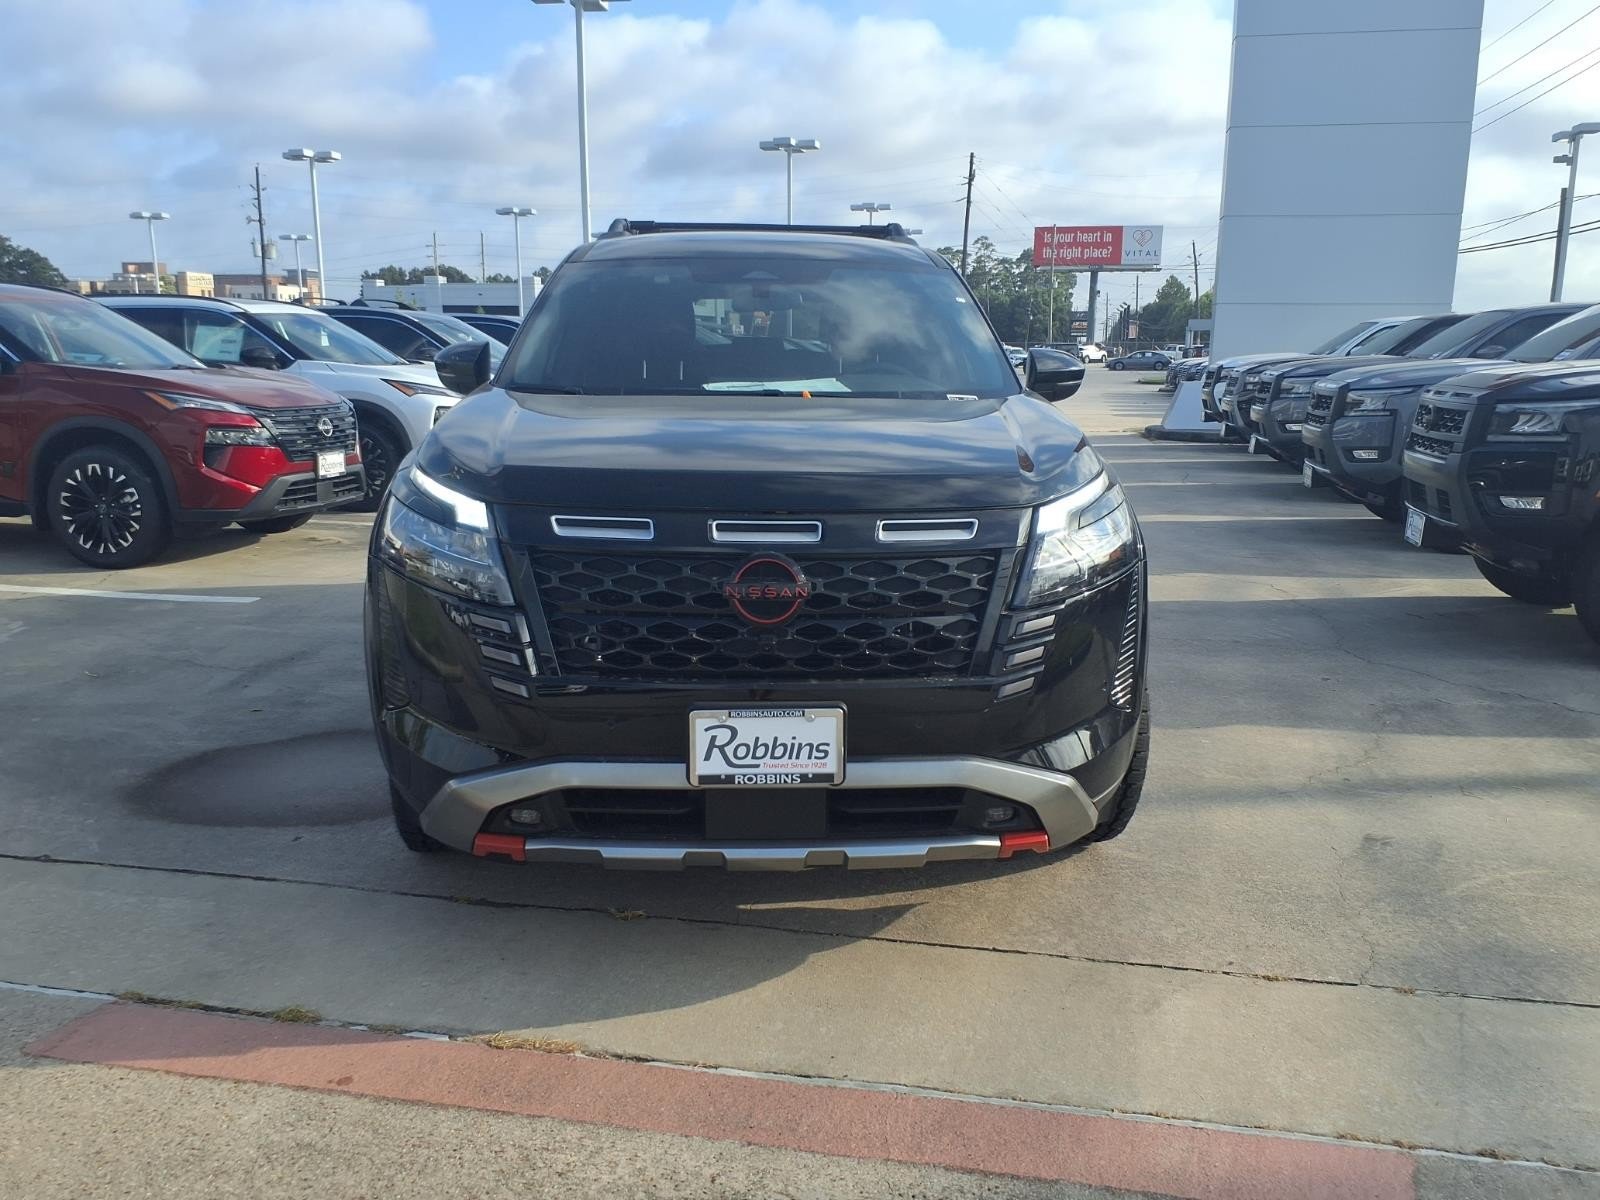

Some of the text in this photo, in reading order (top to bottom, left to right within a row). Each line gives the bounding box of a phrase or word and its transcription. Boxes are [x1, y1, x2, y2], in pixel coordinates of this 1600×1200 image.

[1044, 230, 1112, 245] Is your heart in
[1042, 246, 1113, 260] the right place?
[1125, 249, 1159, 257] VITAL
[725, 586, 808, 598] NISSAN
[730, 710, 803, 718] ROBBINSAUTO.COM
[703, 724, 830, 769] Robbins
[734, 773, 801, 785] ROBBINS
